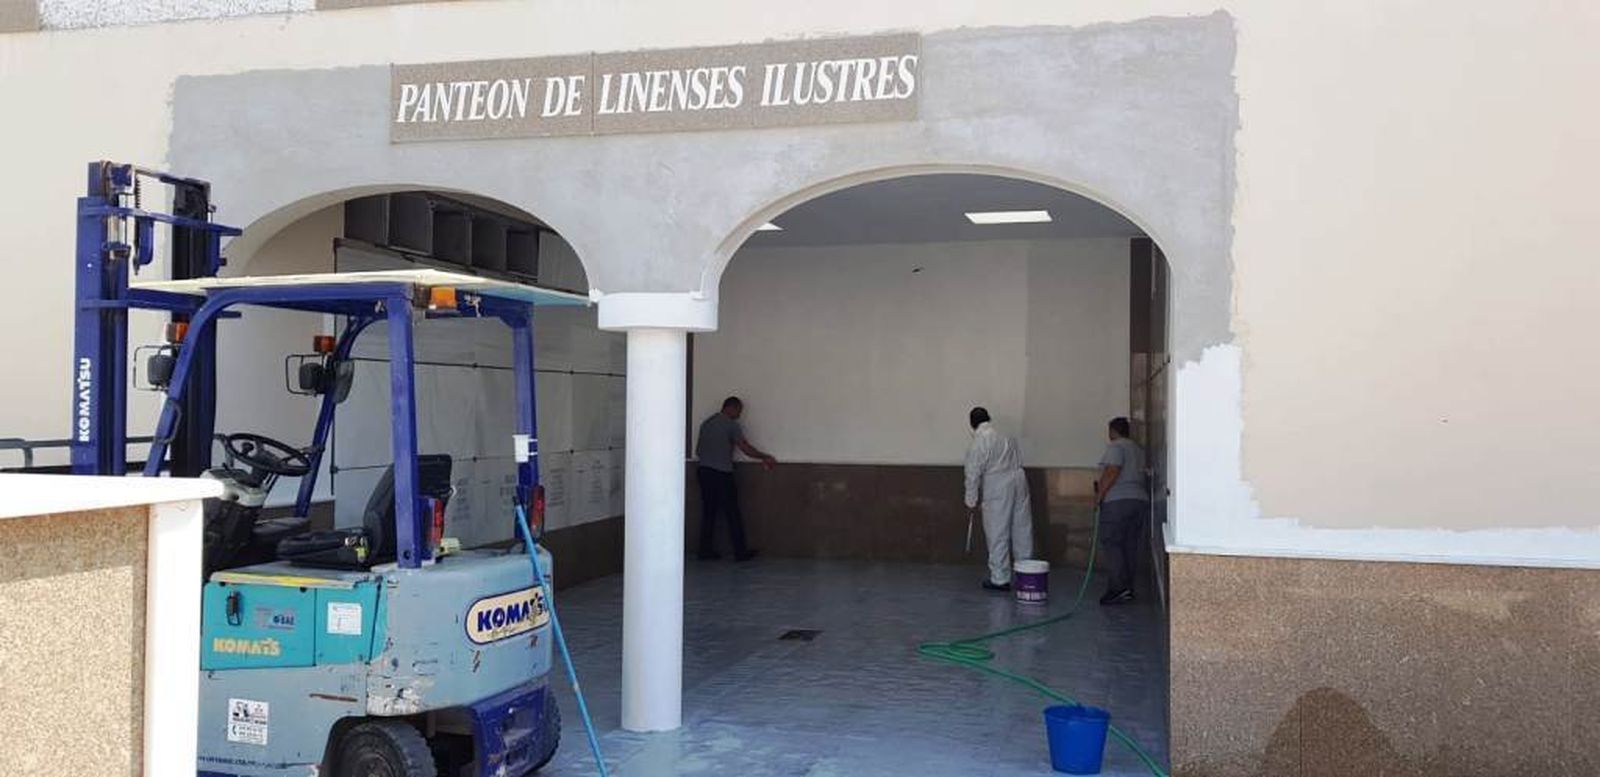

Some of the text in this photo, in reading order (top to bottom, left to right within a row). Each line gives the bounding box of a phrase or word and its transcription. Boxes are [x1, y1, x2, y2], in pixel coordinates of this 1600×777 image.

[397, 55, 918, 123] PANTEON DE LINENSES ILUSTRES
[78, 357, 91, 442] KOMATSU
